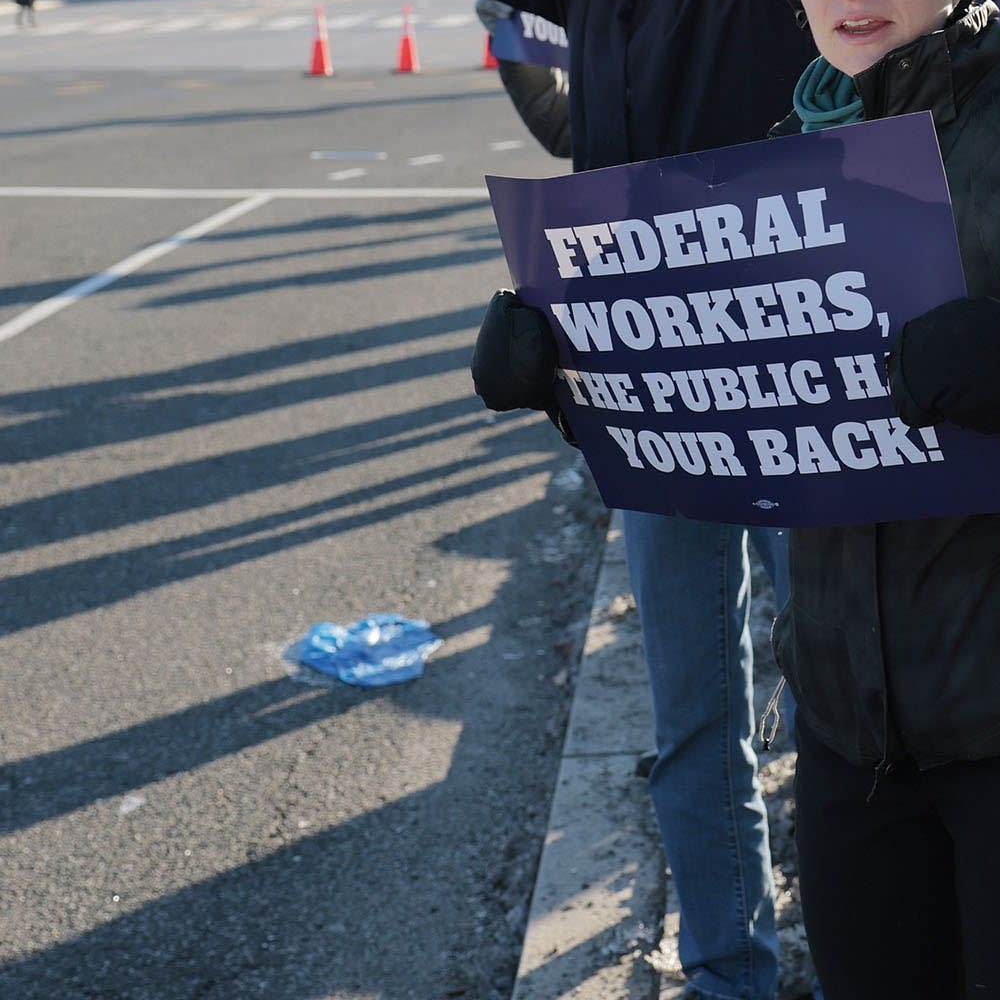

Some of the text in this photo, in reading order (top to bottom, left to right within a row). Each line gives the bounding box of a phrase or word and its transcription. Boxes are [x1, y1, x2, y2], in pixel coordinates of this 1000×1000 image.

[544, 187, 847, 279] FEDERAL
[550, 271, 890, 353] WORKERS,
[557, 368, 645, 413] THE
[642, 360, 831, 413] PUBLIC
[606, 417, 945, 477] YOUR BACK!
